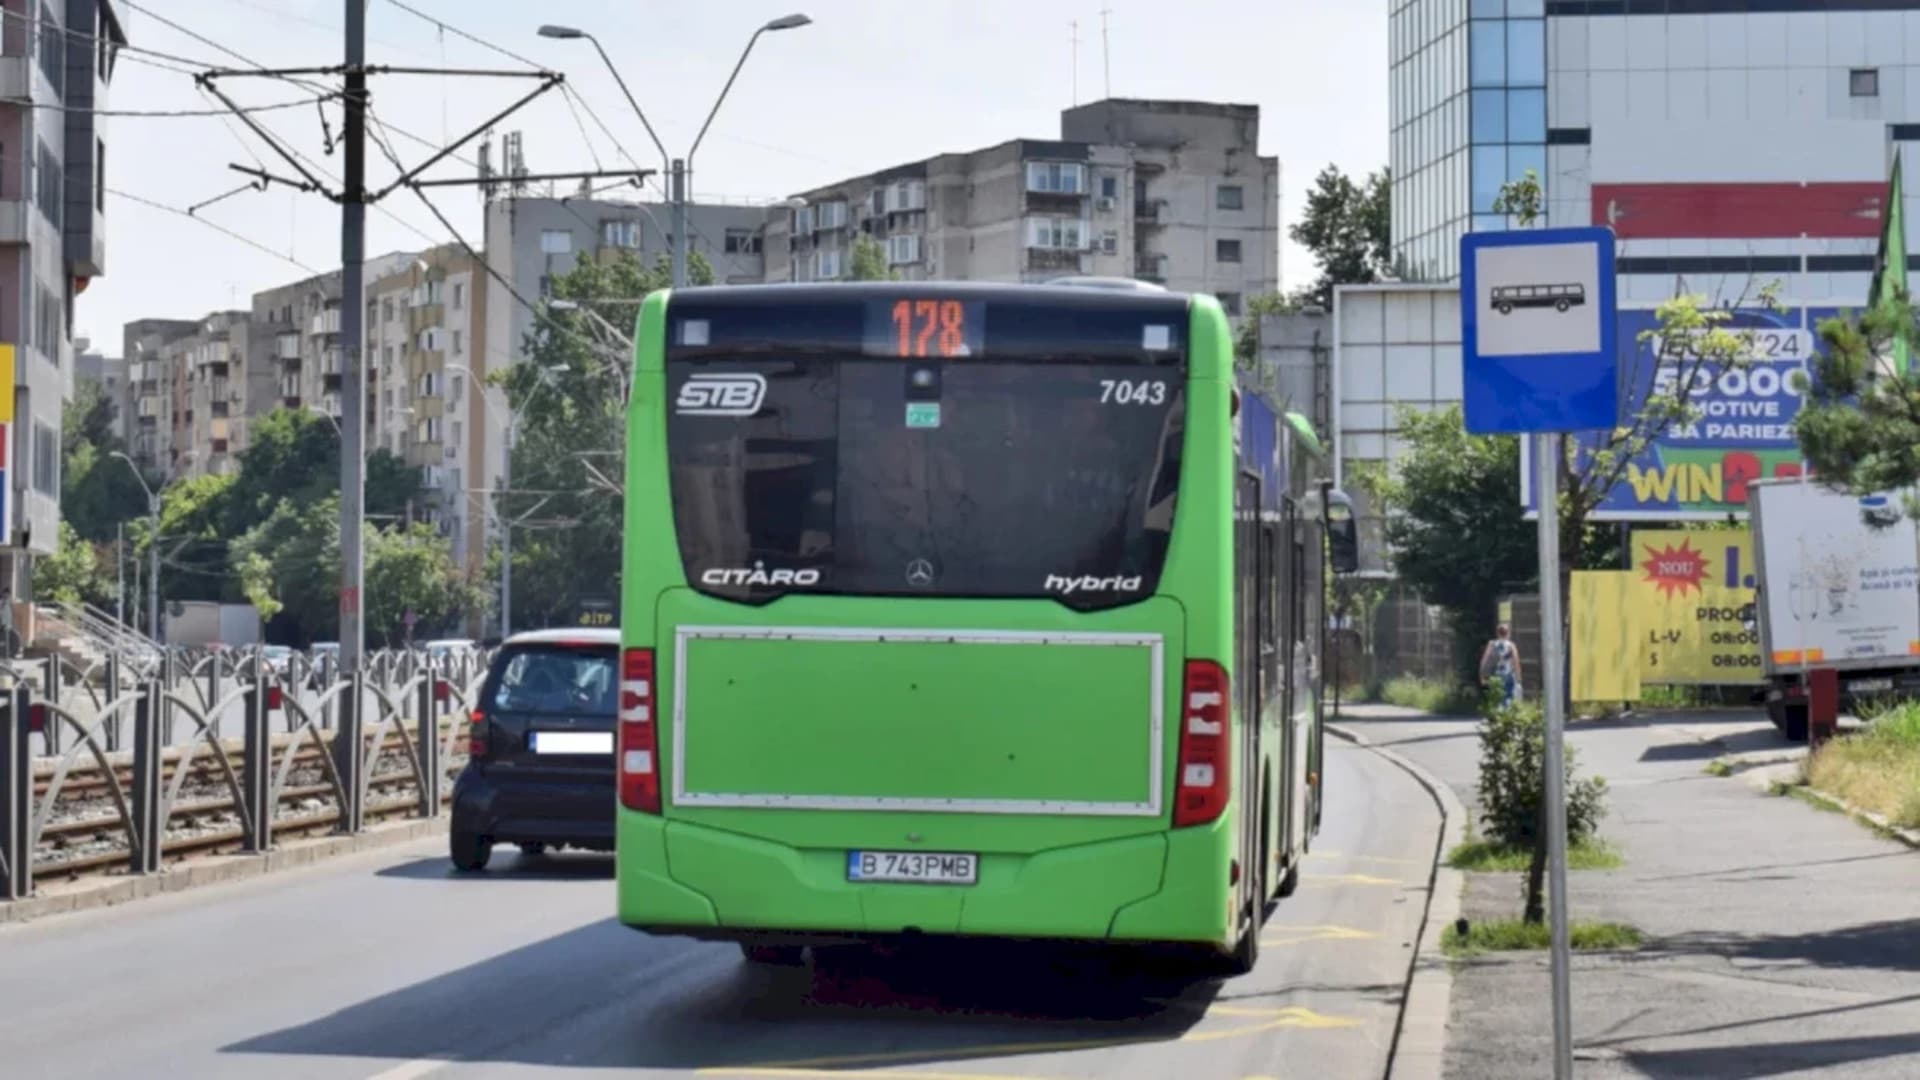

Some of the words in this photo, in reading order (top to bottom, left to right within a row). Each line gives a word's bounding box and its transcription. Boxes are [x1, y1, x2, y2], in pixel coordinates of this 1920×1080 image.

[893, 299, 963, 357] 178
[677, 381, 757, 407] STB
[1101, 380, 1166, 405] 7043
[1658, 560, 1695, 576] NOU
[1044, 574, 1142, 595] hybrid
[1650, 630, 1681, 644] L-V
[1650, 653, 1659, 667] S
[1712, 655, 1761, 668] 08:00
[862, 854, 877, 874] B
[884, 856, 971, 877] 743PMB
